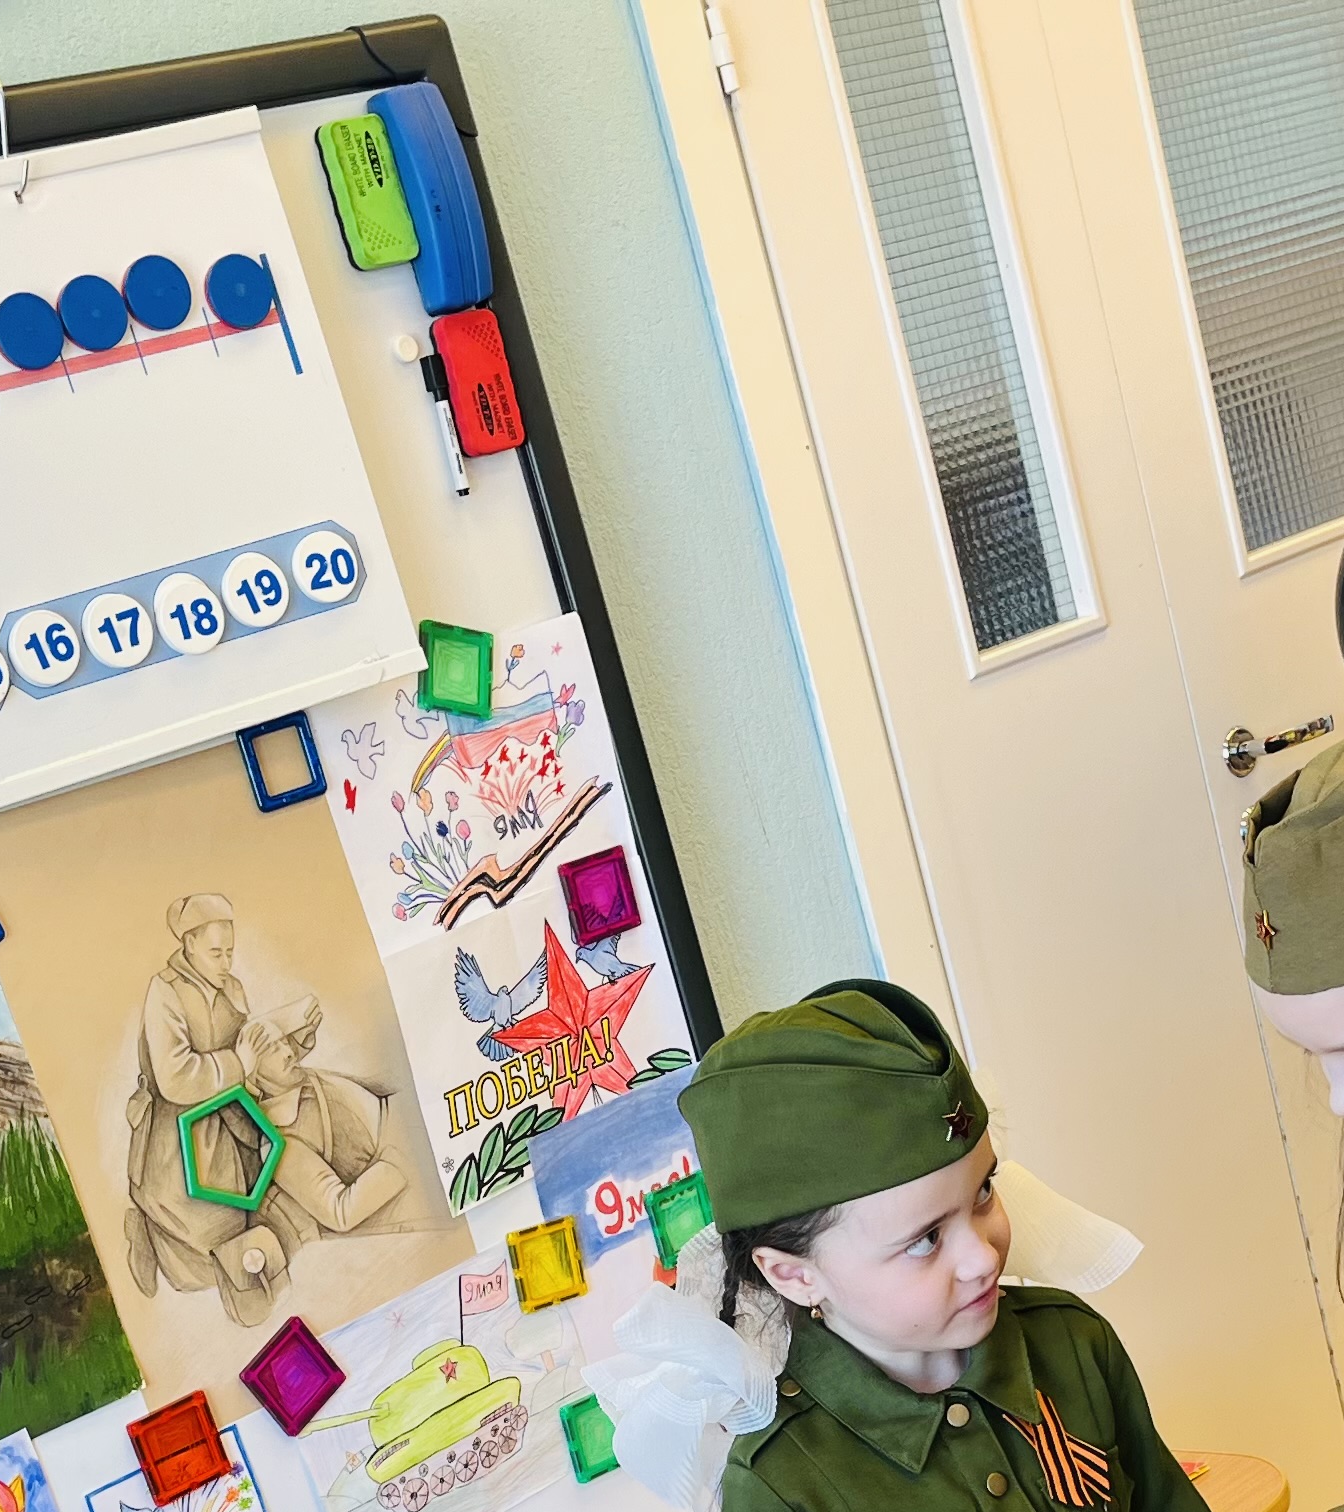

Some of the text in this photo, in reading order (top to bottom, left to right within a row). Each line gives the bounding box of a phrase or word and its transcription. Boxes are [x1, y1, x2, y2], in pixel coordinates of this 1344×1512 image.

[26, 624, 74, 669] 16
[99, 608, 139, 652] 17
[171, 599, 217, 639] 18
[238, 570, 281, 613] 19
[306, 549, 354, 589] 20
[444, 1016, 615, 1138] ПОБЕДА!
